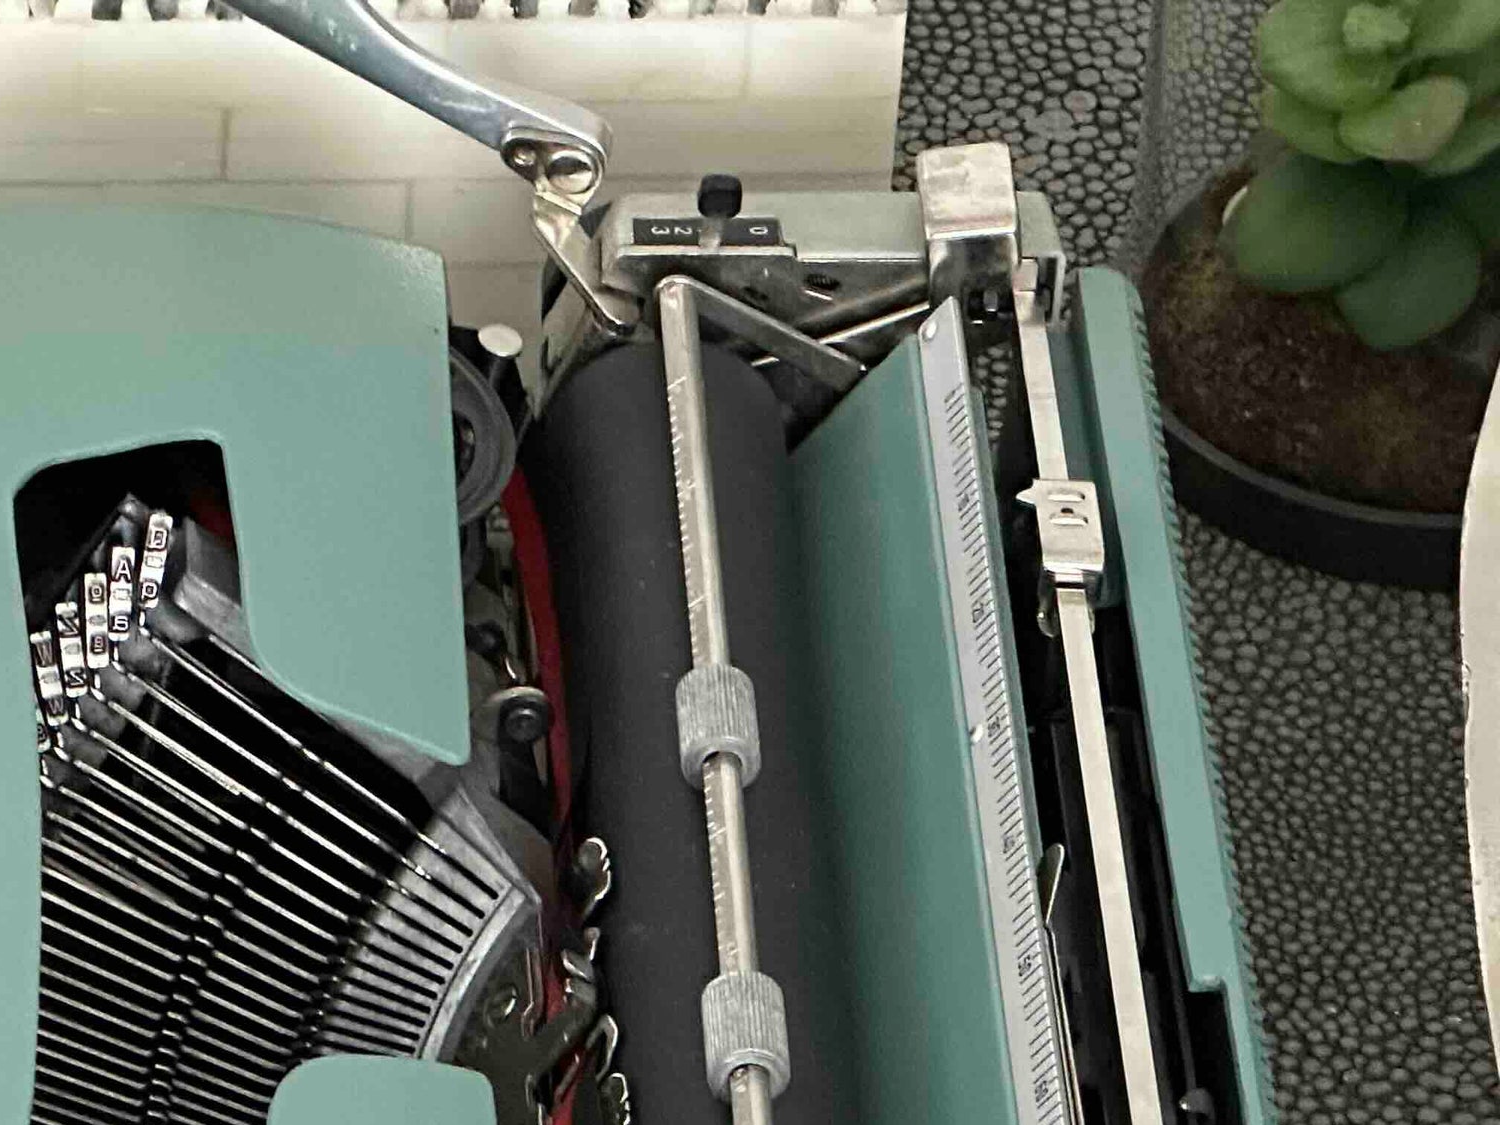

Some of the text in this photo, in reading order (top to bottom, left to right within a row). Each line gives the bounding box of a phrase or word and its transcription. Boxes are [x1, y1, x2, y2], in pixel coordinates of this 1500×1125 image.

[651, 226, 670, 236] 3
[674, 226, 693, 235] 2
[1018, 954, 1032, 977] 50
